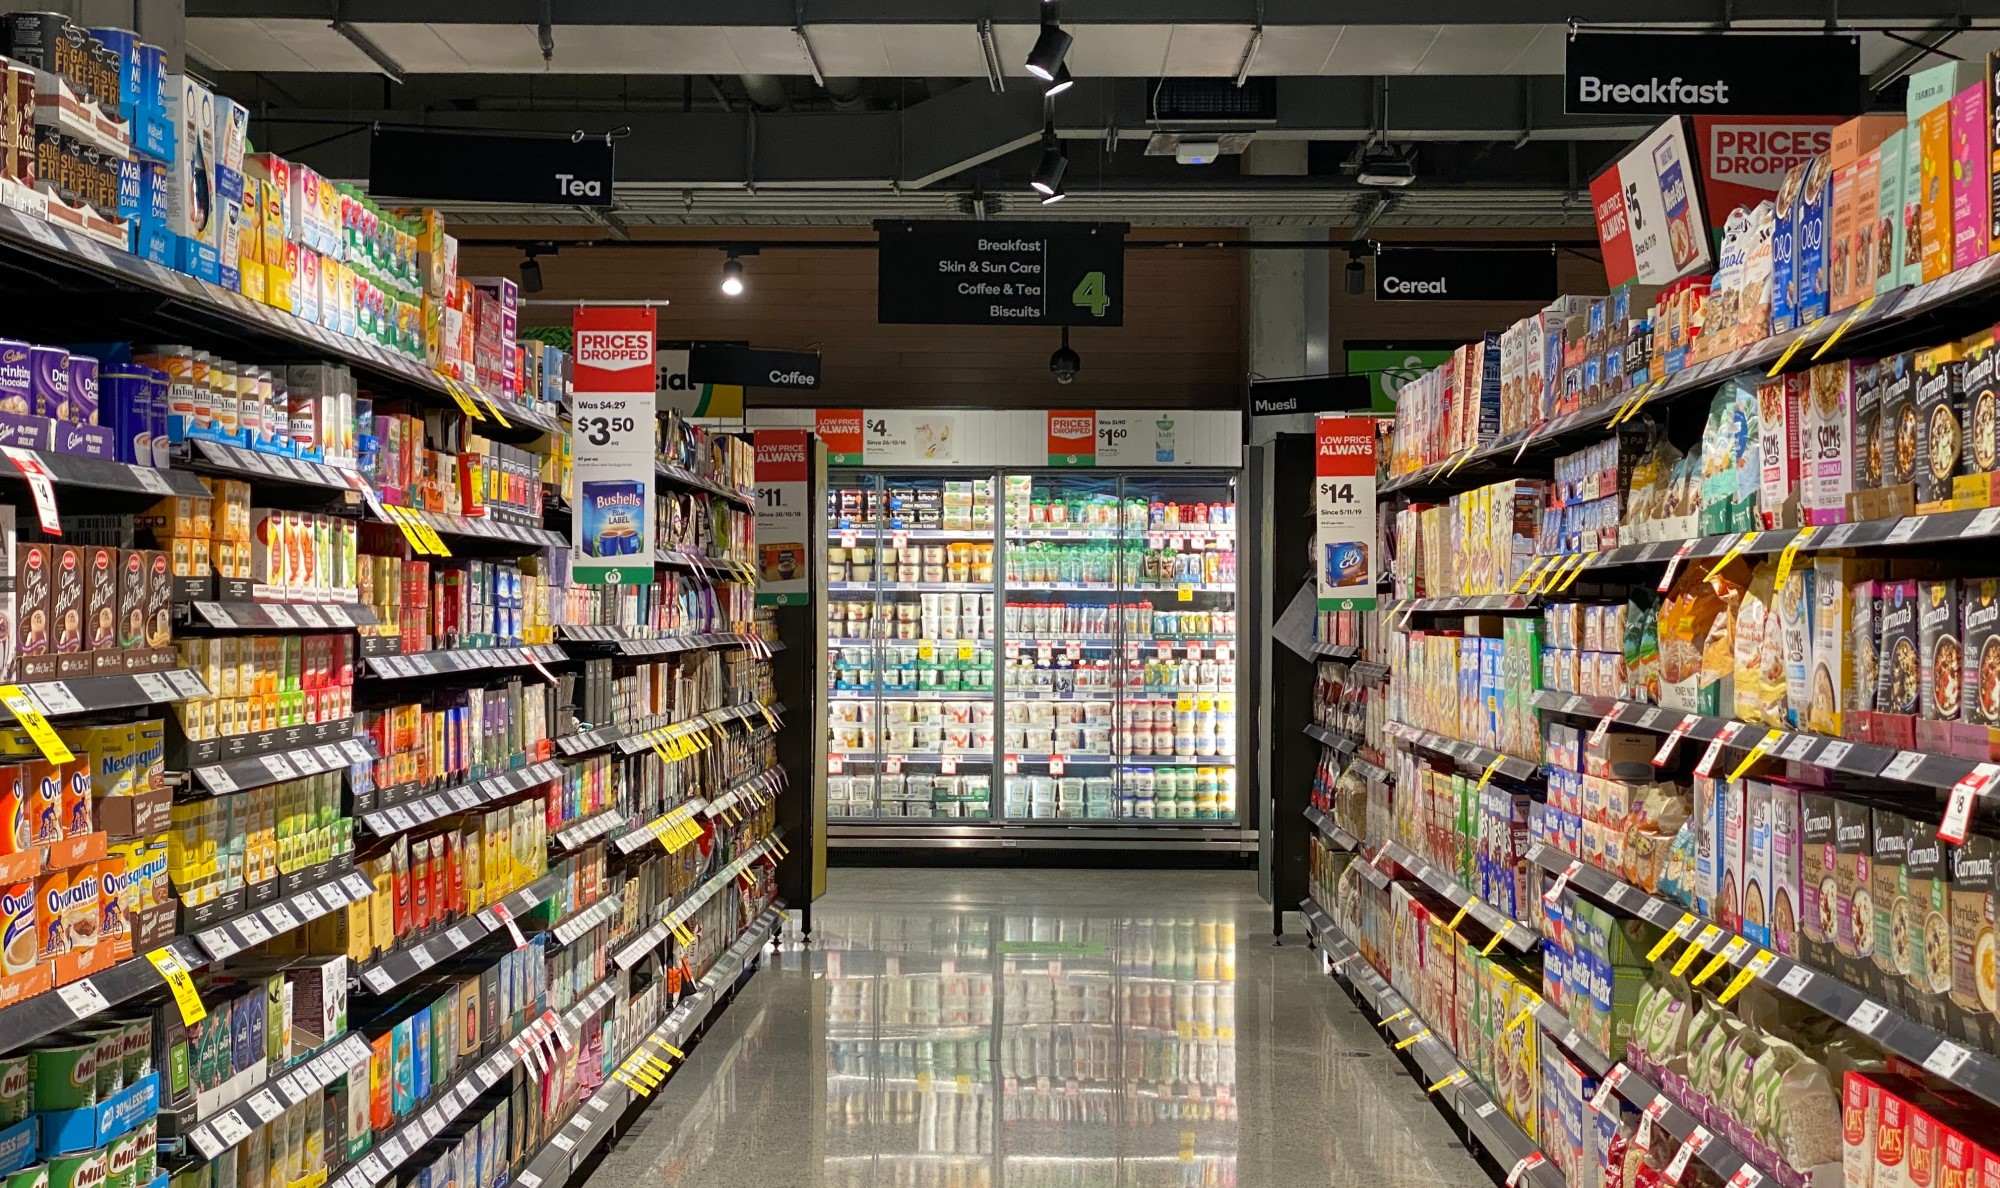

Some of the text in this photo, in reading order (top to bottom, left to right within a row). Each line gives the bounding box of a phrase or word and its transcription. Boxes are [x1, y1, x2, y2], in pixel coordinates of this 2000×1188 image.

[1579, 76, 1729, 104] Breakfast
[1717, 131, 1831, 155] PRICES
[555, 173, 601, 197] Tea
[1598, 192, 1623, 220] LOW PRICE
[1625, 181, 1643, 231] $5
[1601, 213, 1627, 244] ALWAYS
[978, 239, 1041, 251] Breakfast
[939, 260, 1041, 274] Skin & Sun Care
[958, 282, 1041, 296] Coffee & Tea
[1072, 271, 1110, 317] 4
[1383, 276, 1447, 294] Cereal
[990, 305, 1041, 317] Biscuits
[581, 335, 648, 349] PRICES
[581, 350, 648, 361] DROPPED
[0, 364, 30, 382] rinking
[769, 370, 815, 385] Coffee
[1962, 350, 1993, 392] Carman's
[1916, 365, 1948, 406] Carman's
[578, 401, 626, 410] Was $4.29
[1255, 398, 1297, 412] Muesli
[866, 419, 887, 437] $4
[1053, 420, 1090, 428] PRICES
[67, 432, 83, 450] Cadbury
[1320, 436, 1372, 444] LOW PRICE
[757, 452, 805, 462] ALWAYS
[1320, 445, 1373, 456] ALWAYS
[596, 492, 641, 509] Bushells
[758, 488, 781, 507] $11
[1320, 483, 1354, 504] $14
[608, 516, 629, 525] LABEL
[612, 509, 626, 517] Blue
[1921, 599, 1950, 630] Carman's
[1965, 599, 1998, 629] Carman's
[102, 752, 135, 775] Nesq
[1803, 807, 1832, 833] Carman's
[1837, 817, 1865, 842] Carman's
[1907, 840, 1940, 866] Carman's
[1884, 1096, 1900, 1114] UNCLE
[1845, 1106, 1863, 1133] OATS
[1913, 1113, 1928, 1133] UNCLE
[1878, 1124, 1901, 1151] OATS
[1947, 1133, 1964, 1155] UNCLE
[1910, 1143, 1930, 1170] OATS
